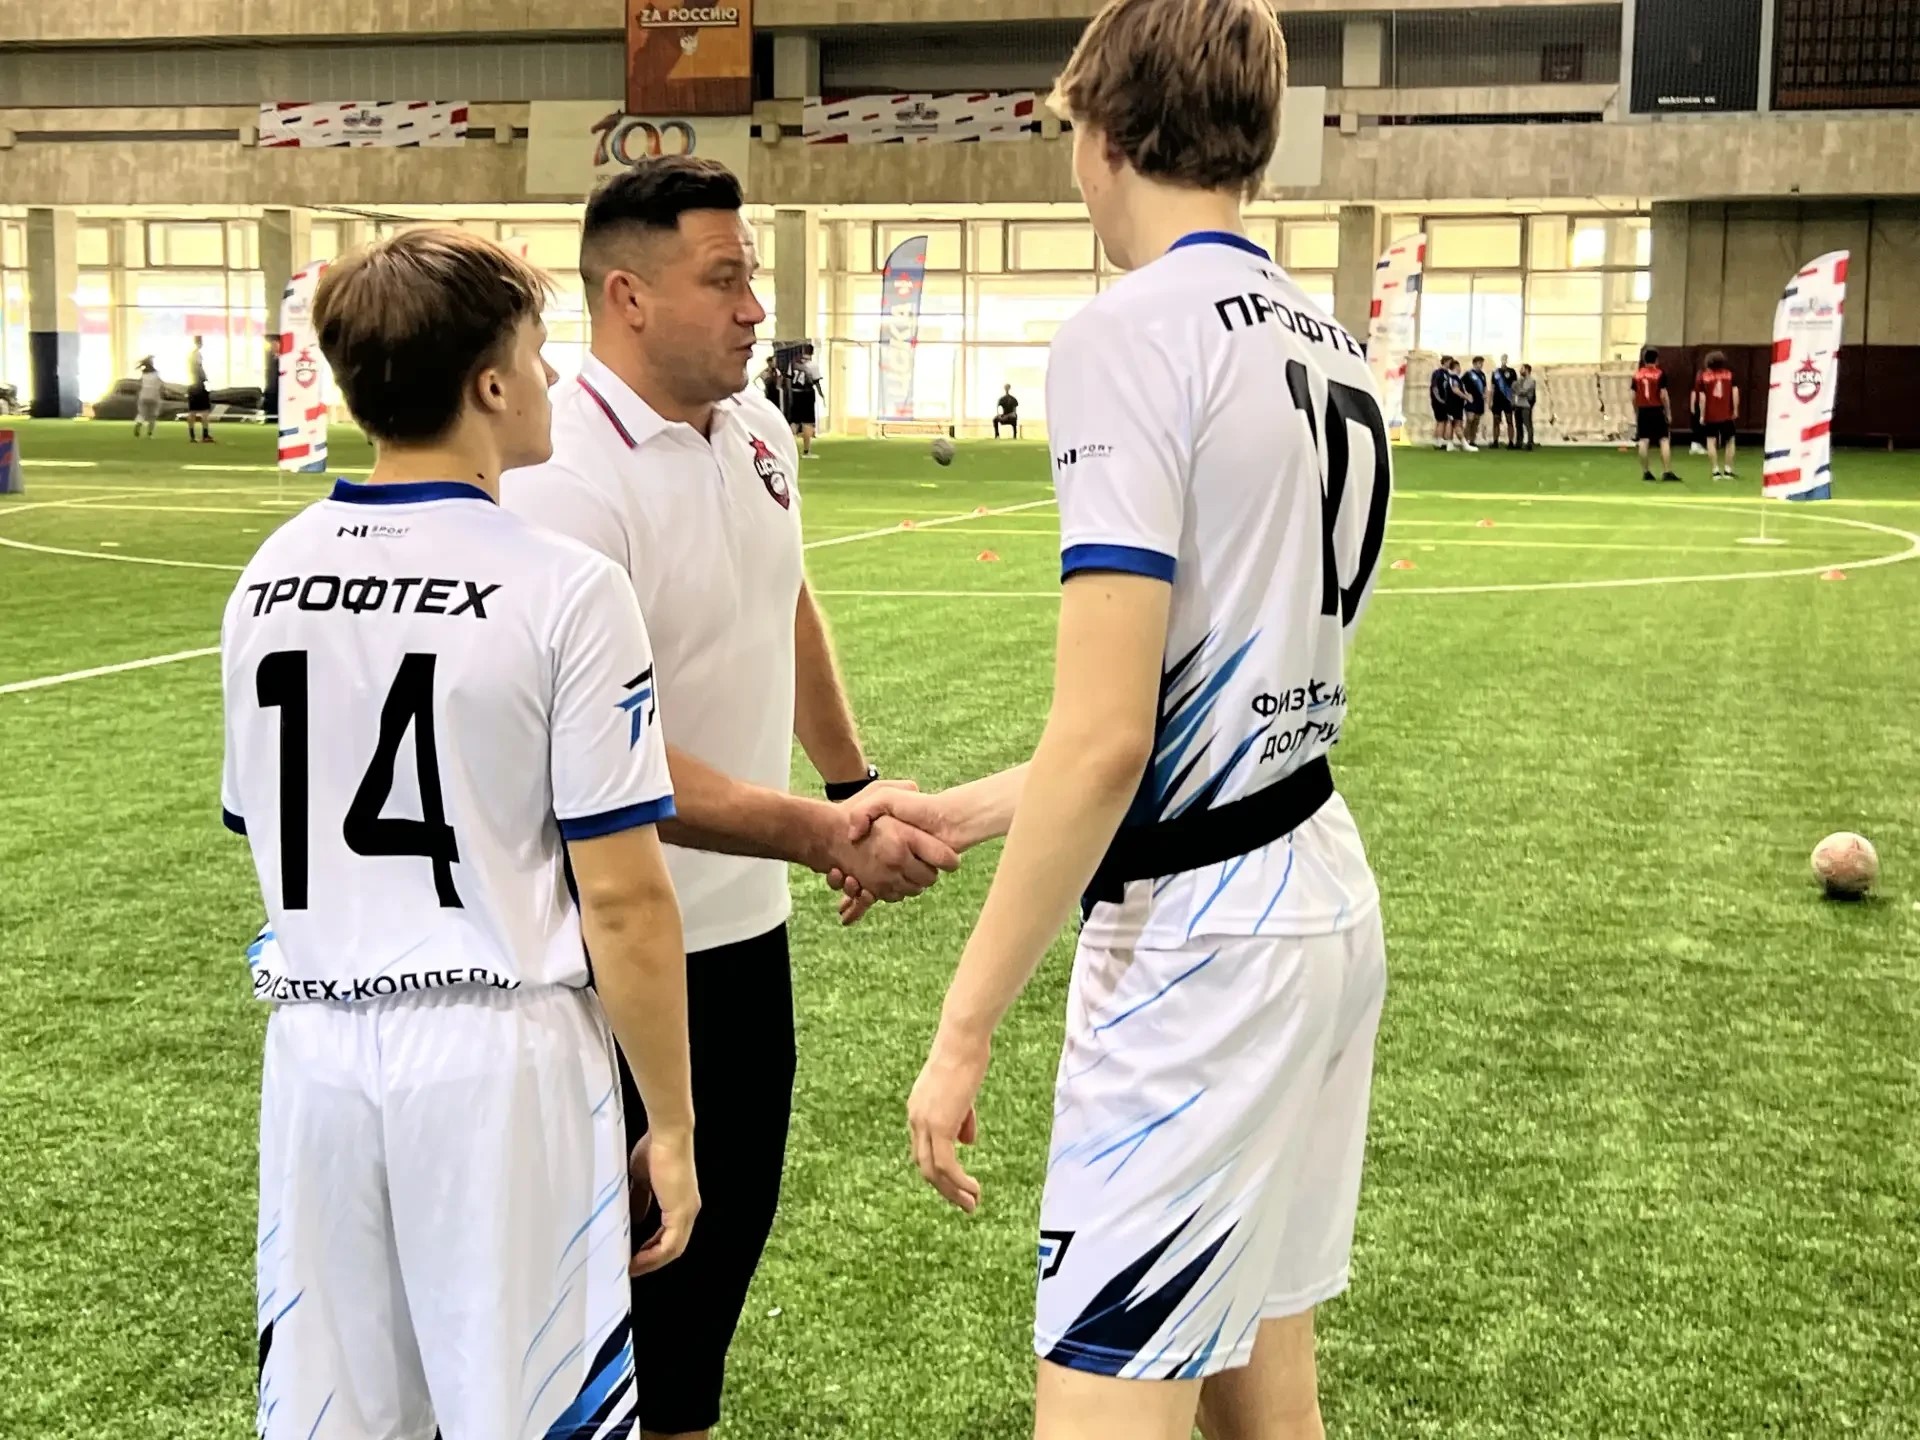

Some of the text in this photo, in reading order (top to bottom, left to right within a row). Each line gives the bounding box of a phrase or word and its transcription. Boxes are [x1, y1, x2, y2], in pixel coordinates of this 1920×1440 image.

[668, 7, 738, 21] РОССИЮ
[246, 575, 502, 619] ПРОФТЕХ
[256, 649, 465, 910] 14
